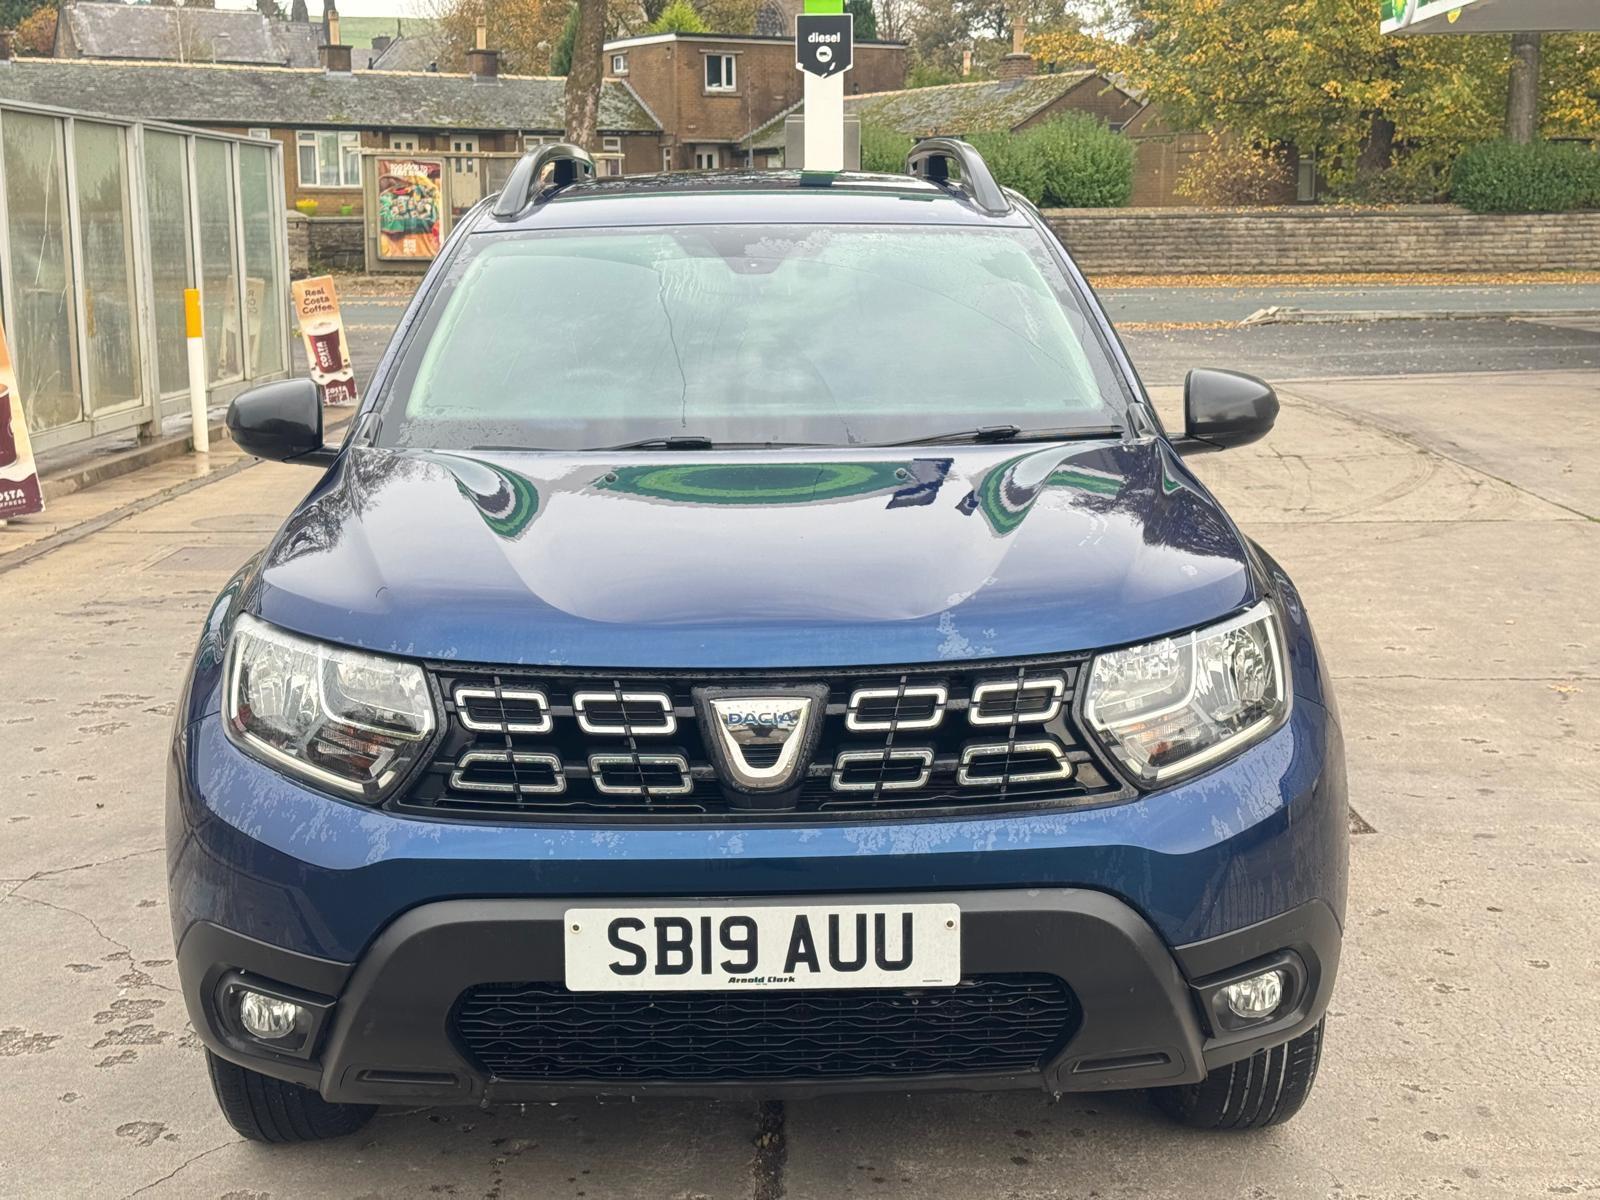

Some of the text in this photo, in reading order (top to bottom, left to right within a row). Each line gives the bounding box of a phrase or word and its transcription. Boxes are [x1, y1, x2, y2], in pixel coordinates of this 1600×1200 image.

[807, 32, 841, 43] diesel
[304, 287, 325, 297] Real
[303, 296, 330, 306] Costa
[302, 304, 335, 314] Coffee.
[316, 341, 329, 368] COSTA
[728, 712, 795, 725] DACIA
[607, 912, 914, 976] SB19 AUU
[728, 976, 796, 984] Arnold Clark
